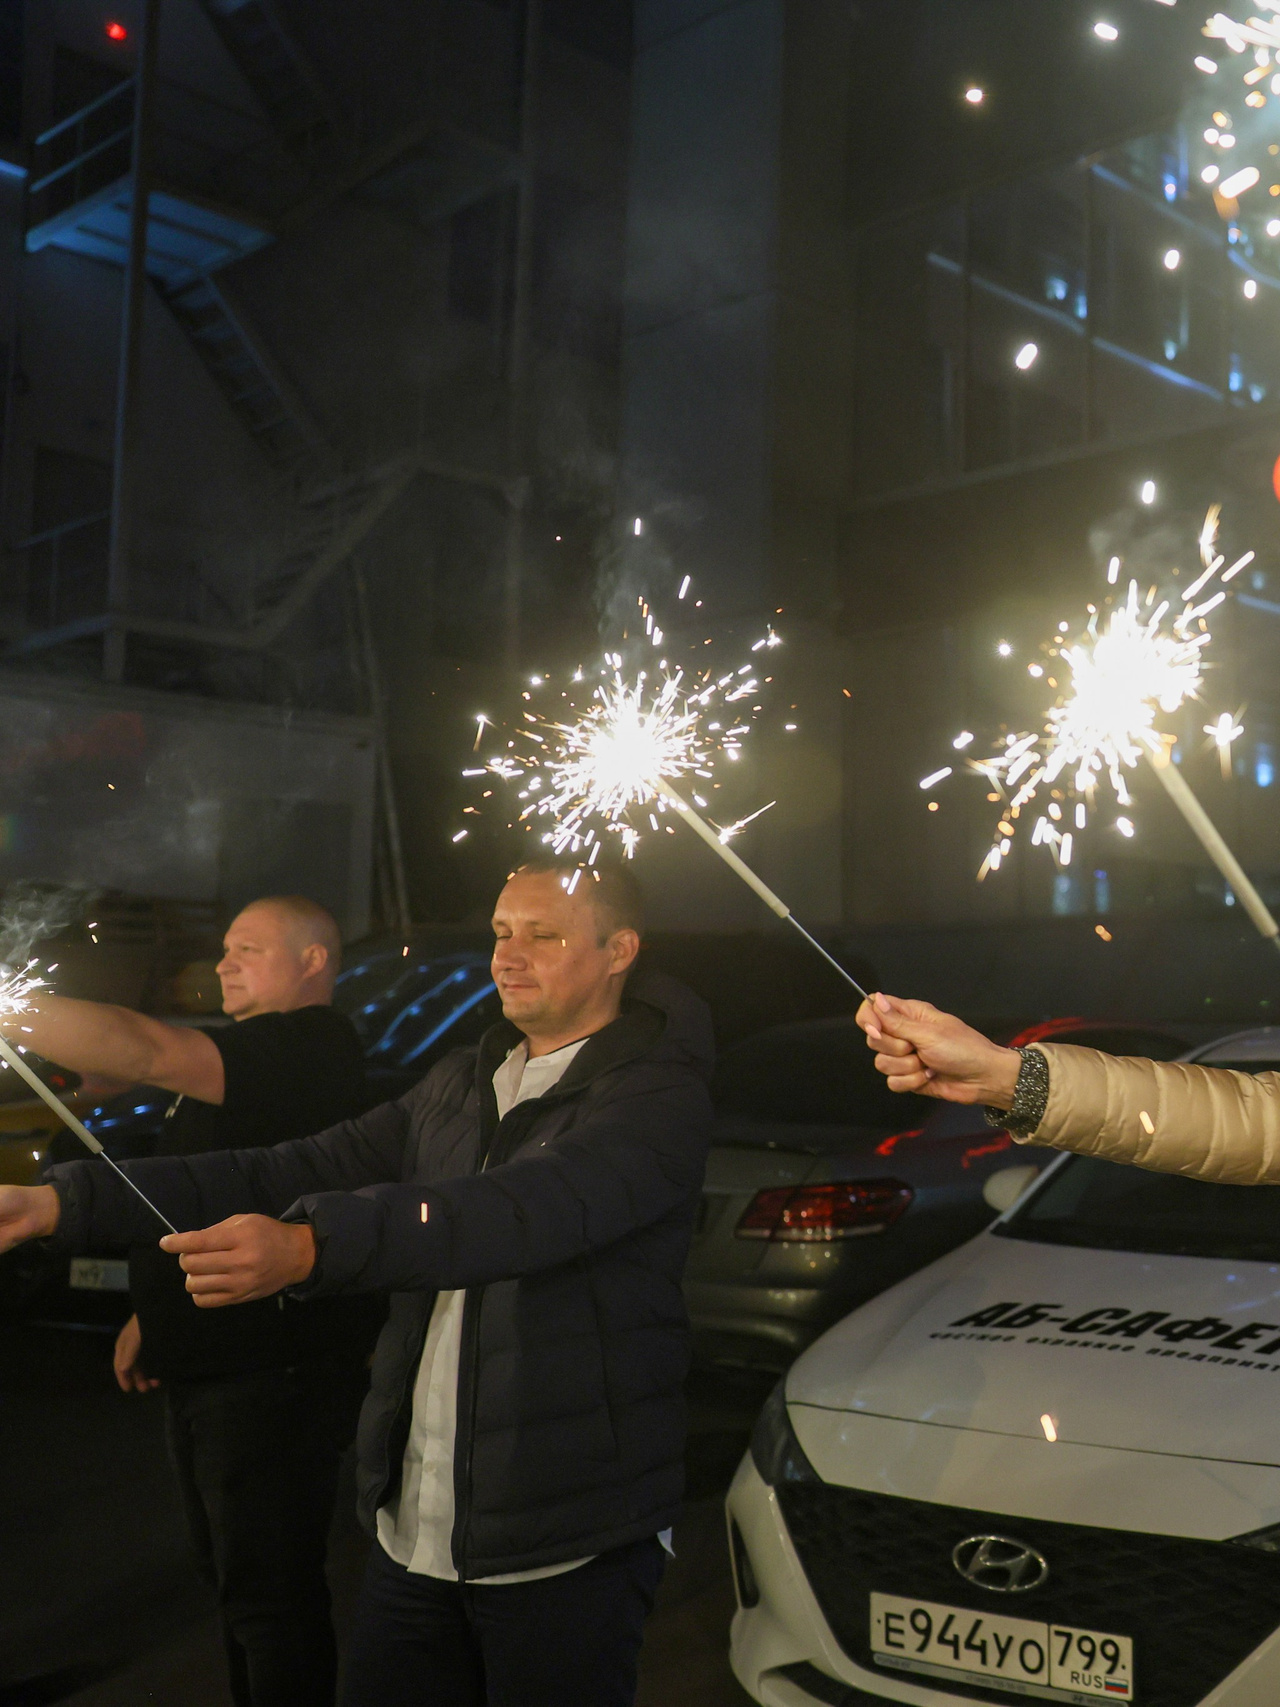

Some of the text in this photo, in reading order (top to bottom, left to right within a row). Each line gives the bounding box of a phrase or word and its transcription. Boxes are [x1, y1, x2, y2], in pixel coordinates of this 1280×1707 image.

[884, 1608, 1120, 1675] Е944УО 799
[1070, 1671, 1103, 1689] RUS
